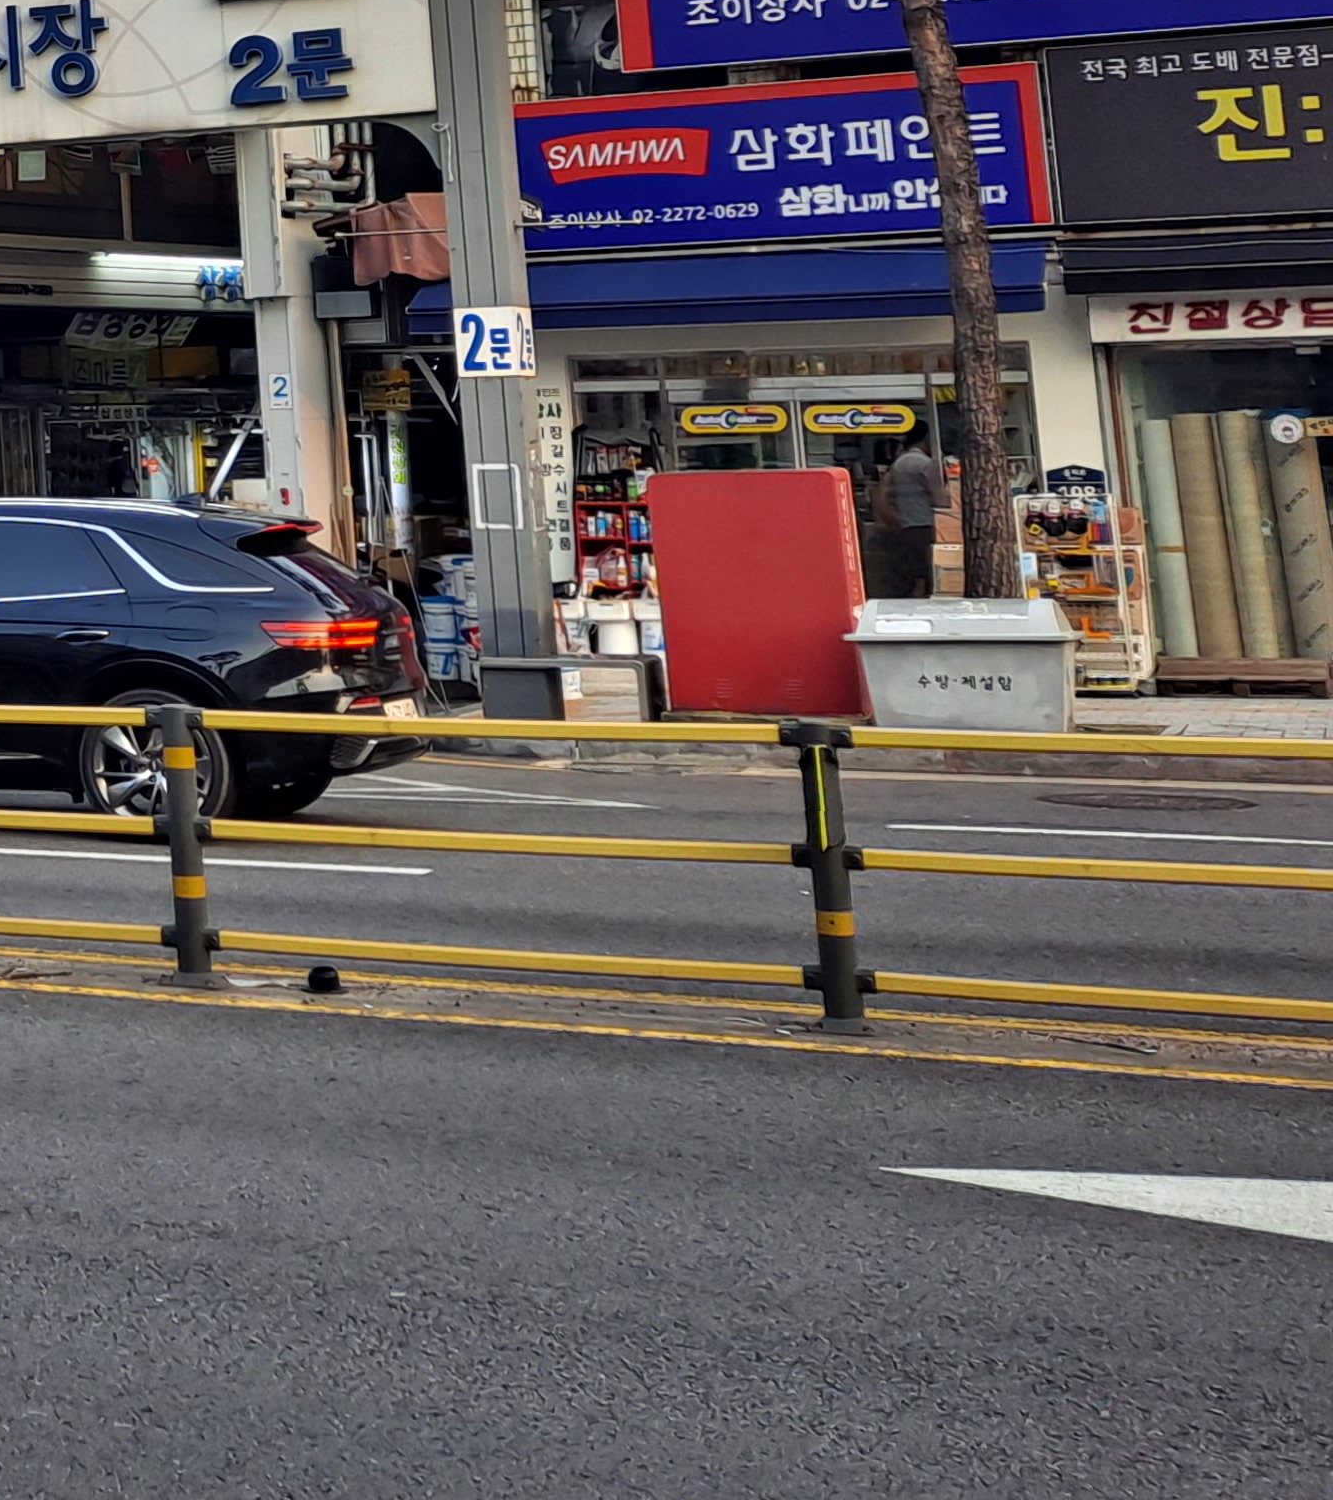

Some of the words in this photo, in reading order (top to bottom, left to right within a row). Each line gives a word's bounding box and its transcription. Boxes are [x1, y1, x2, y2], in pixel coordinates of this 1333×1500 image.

[228, 26, 356, 106] 2문
[1081, 57, 1129, 82] 전국
[1135, 53, 1183, 78] 최고
[1190, 49, 1239, 72] 도배
[548, 137, 686, 171] SAMHWA
[632, 202, 760, 224] 02-2272-0629
[779, 183, 891, 217] 삼화니까
[460, 313, 513, 372] 2문
[273, 376, 288, 398] 2
